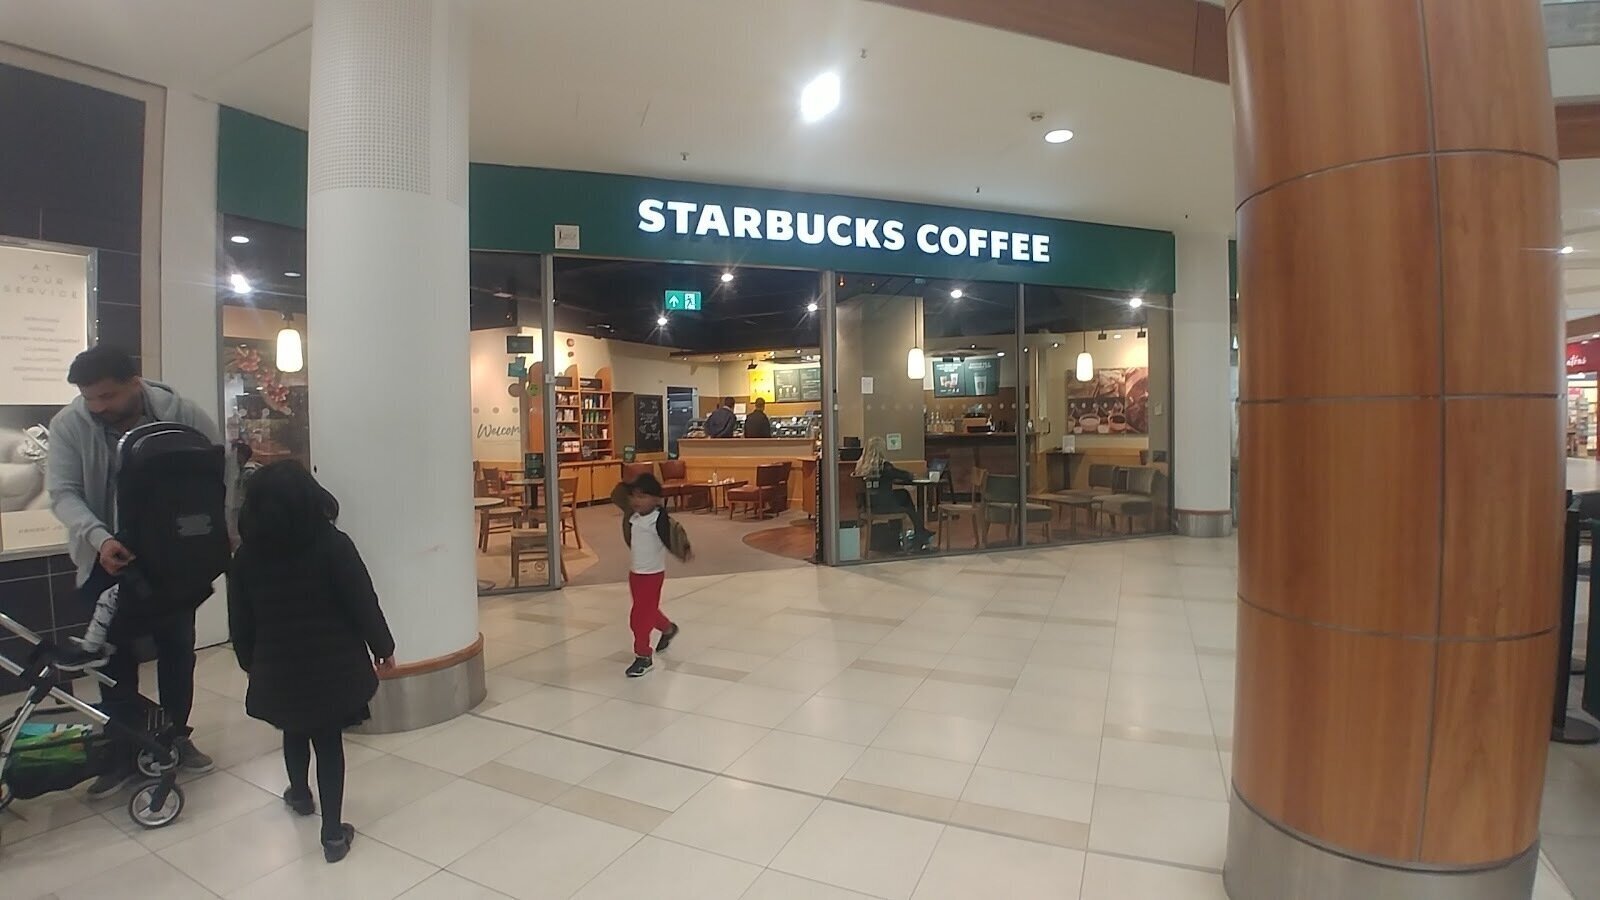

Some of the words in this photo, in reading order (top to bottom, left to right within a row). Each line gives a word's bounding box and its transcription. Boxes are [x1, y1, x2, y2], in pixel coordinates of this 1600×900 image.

[638, 199, 905, 251] STARBUCKS
[916, 223, 1050, 263] COFFEE
[32, 263, 52, 271] AT
[18, 275, 64, 285] YOUR
[4, 285, 78, 299] SERVICE
[477, 423, 520, 438] Welcom
